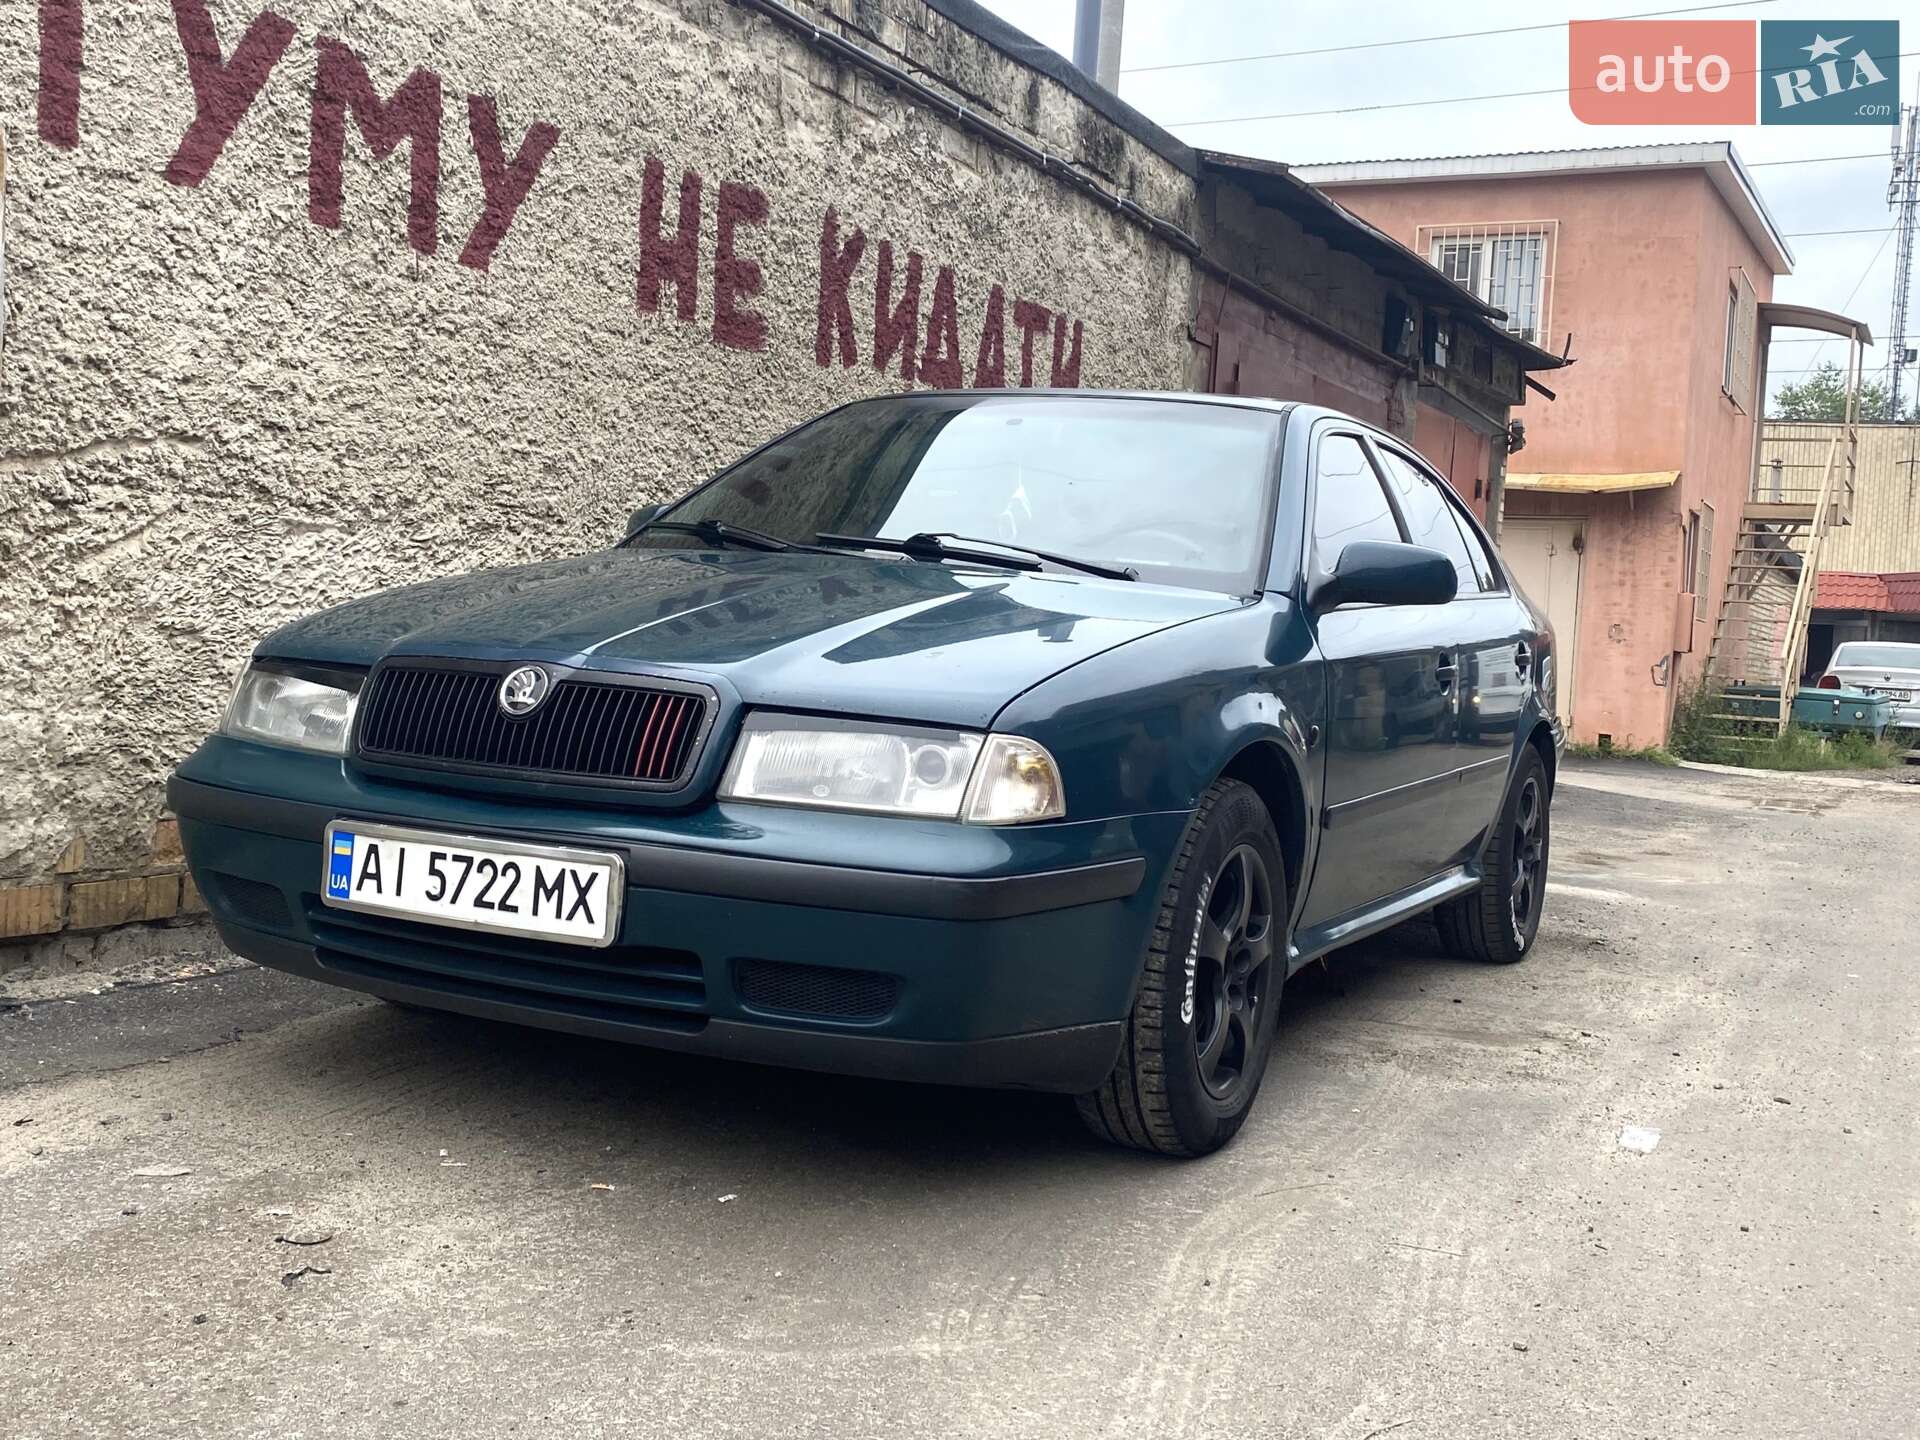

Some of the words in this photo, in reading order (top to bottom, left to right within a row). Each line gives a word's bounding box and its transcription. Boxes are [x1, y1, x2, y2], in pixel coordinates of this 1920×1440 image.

[636, 157, 768, 352] НЕ
[815, 205, 1083, 388] КИДАТИ
[331, 874, 349, 891] UA
[356, 843, 405, 897] AI
[425, 851, 521, 913] 5722
[532, 865, 598, 924] MX
